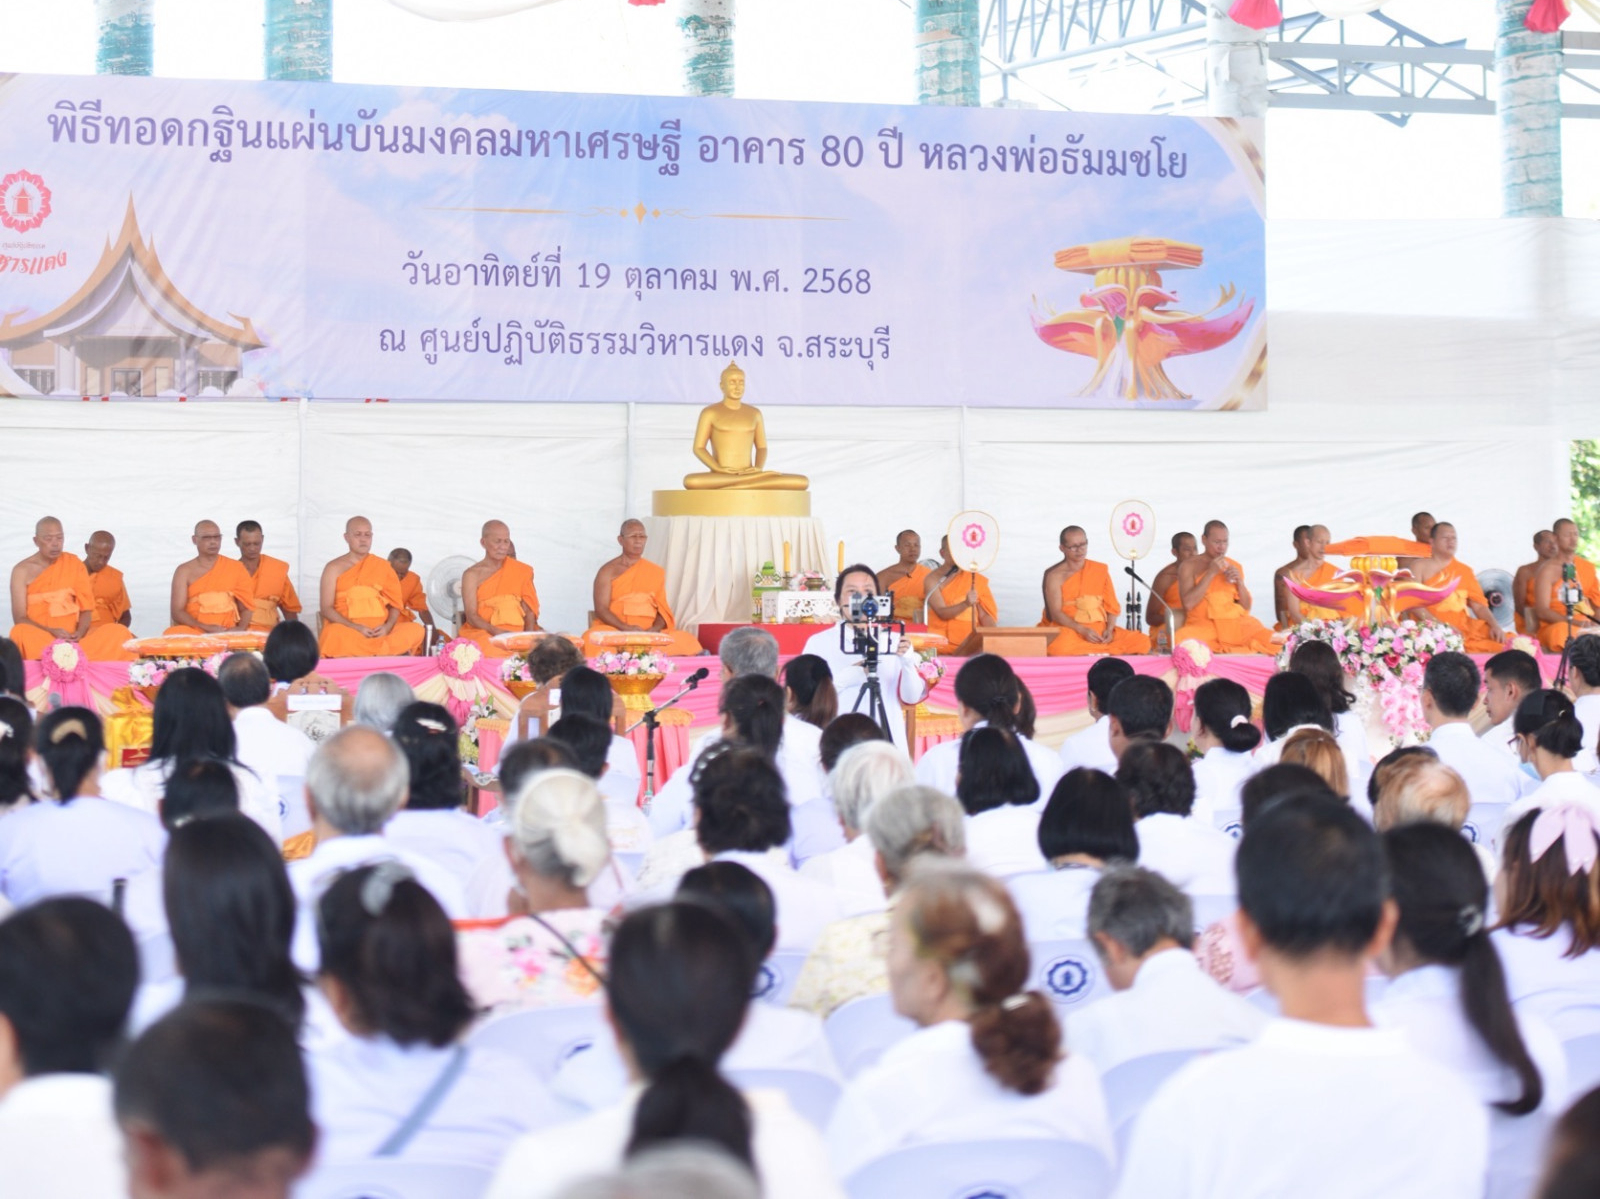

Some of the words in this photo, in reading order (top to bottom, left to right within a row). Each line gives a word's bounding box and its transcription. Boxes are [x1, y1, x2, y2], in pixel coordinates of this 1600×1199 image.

[698, 134, 805, 166] อาคาร
[821, 135, 864, 168] 80
[878, 126, 904, 169] ปี
[919, 133, 1188, 179] หลวงพ่อธัมมชโย
[402, 245, 562, 288] วันอาทิตย์ที่
[578, 262, 611, 289] 19
[625, 267, 717, 301] ตุลาคม
[730, 269, 790, 292] พ.ศ.
[802, 267, 871, 295] 2568
[379, 328, 406, 352] ณ
[420, 317, 764, 366] ศูนย์ปฏิบัติธรรมวิหารแดง
[777, 325, 891, 371] จ.สระบุรี
